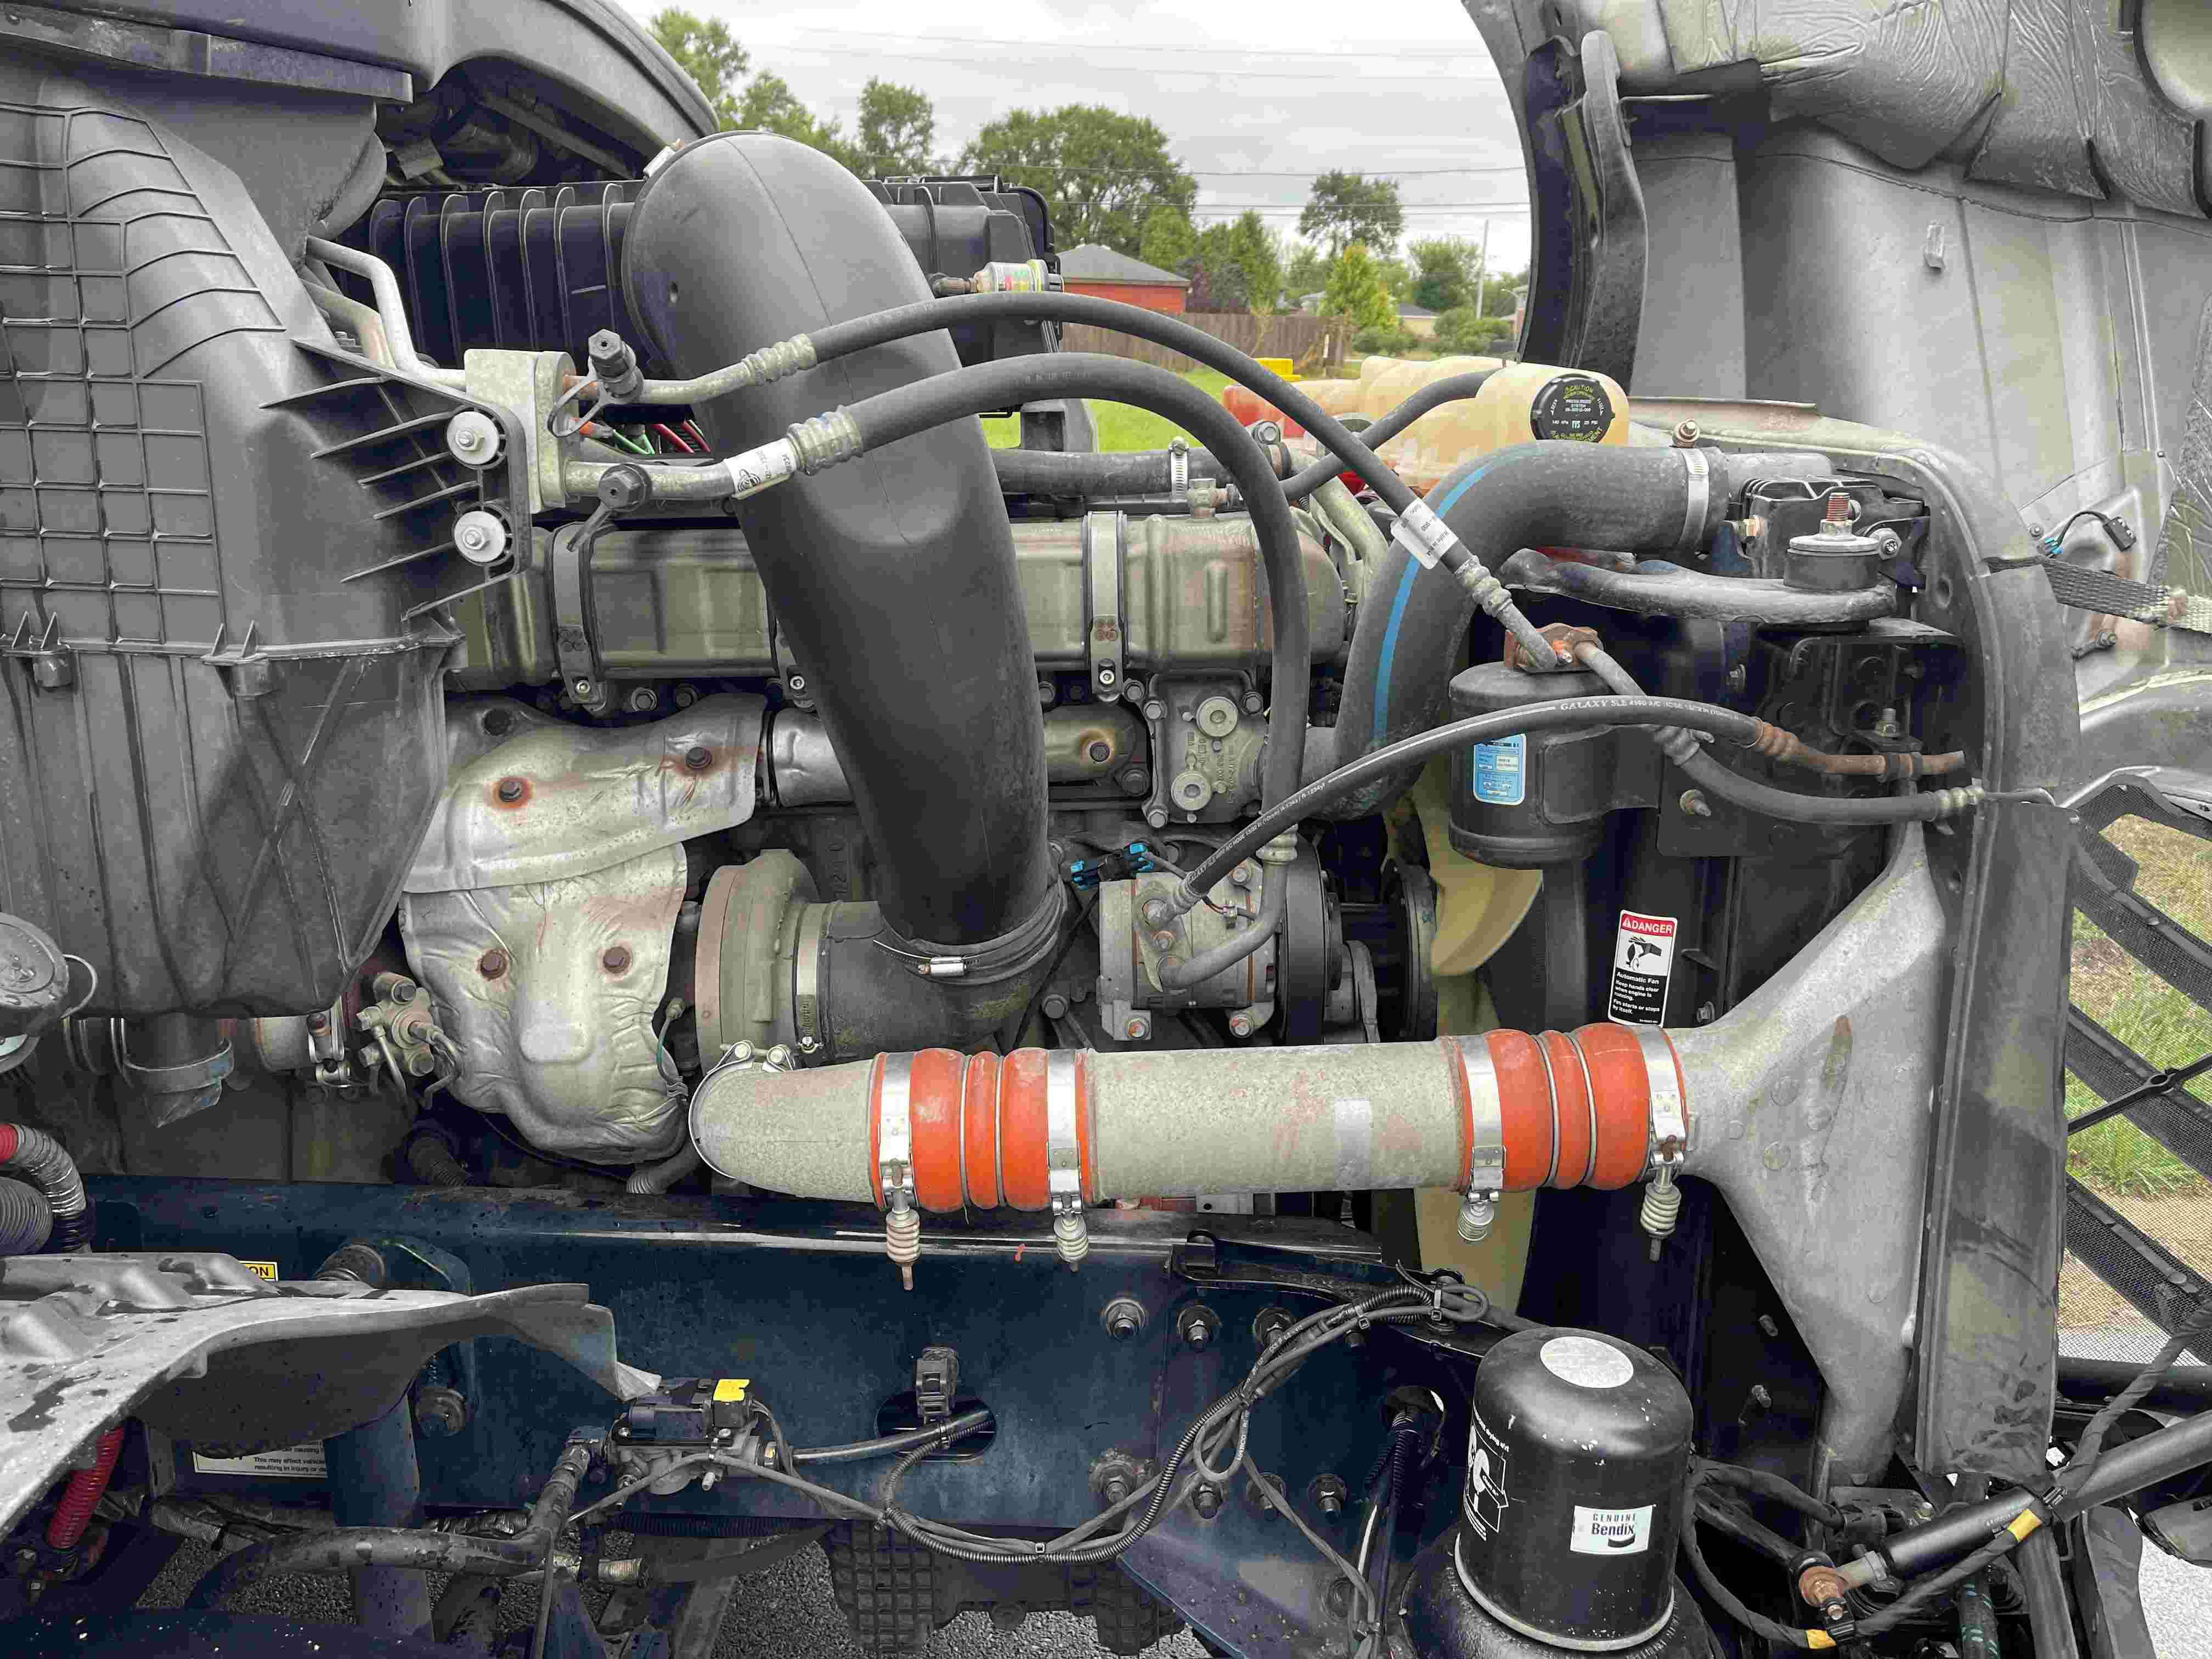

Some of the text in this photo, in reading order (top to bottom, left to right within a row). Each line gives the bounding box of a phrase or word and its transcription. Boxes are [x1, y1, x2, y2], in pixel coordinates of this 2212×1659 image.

[1560, 700, 1609, 711] GALAXY
[1632, 920, 1673, 934] DANGER
[1617, 972, 1646, 983] Automatic
[1615, 979, 1628, 988] Keep
[1614, 991, 1634, 1001] running.
[1619, 1006, 1633, 1014] itself.
[1593, 1513, 1637, 1522] GENUINE
[1592, 1522, 1634, 1536] Bendix
